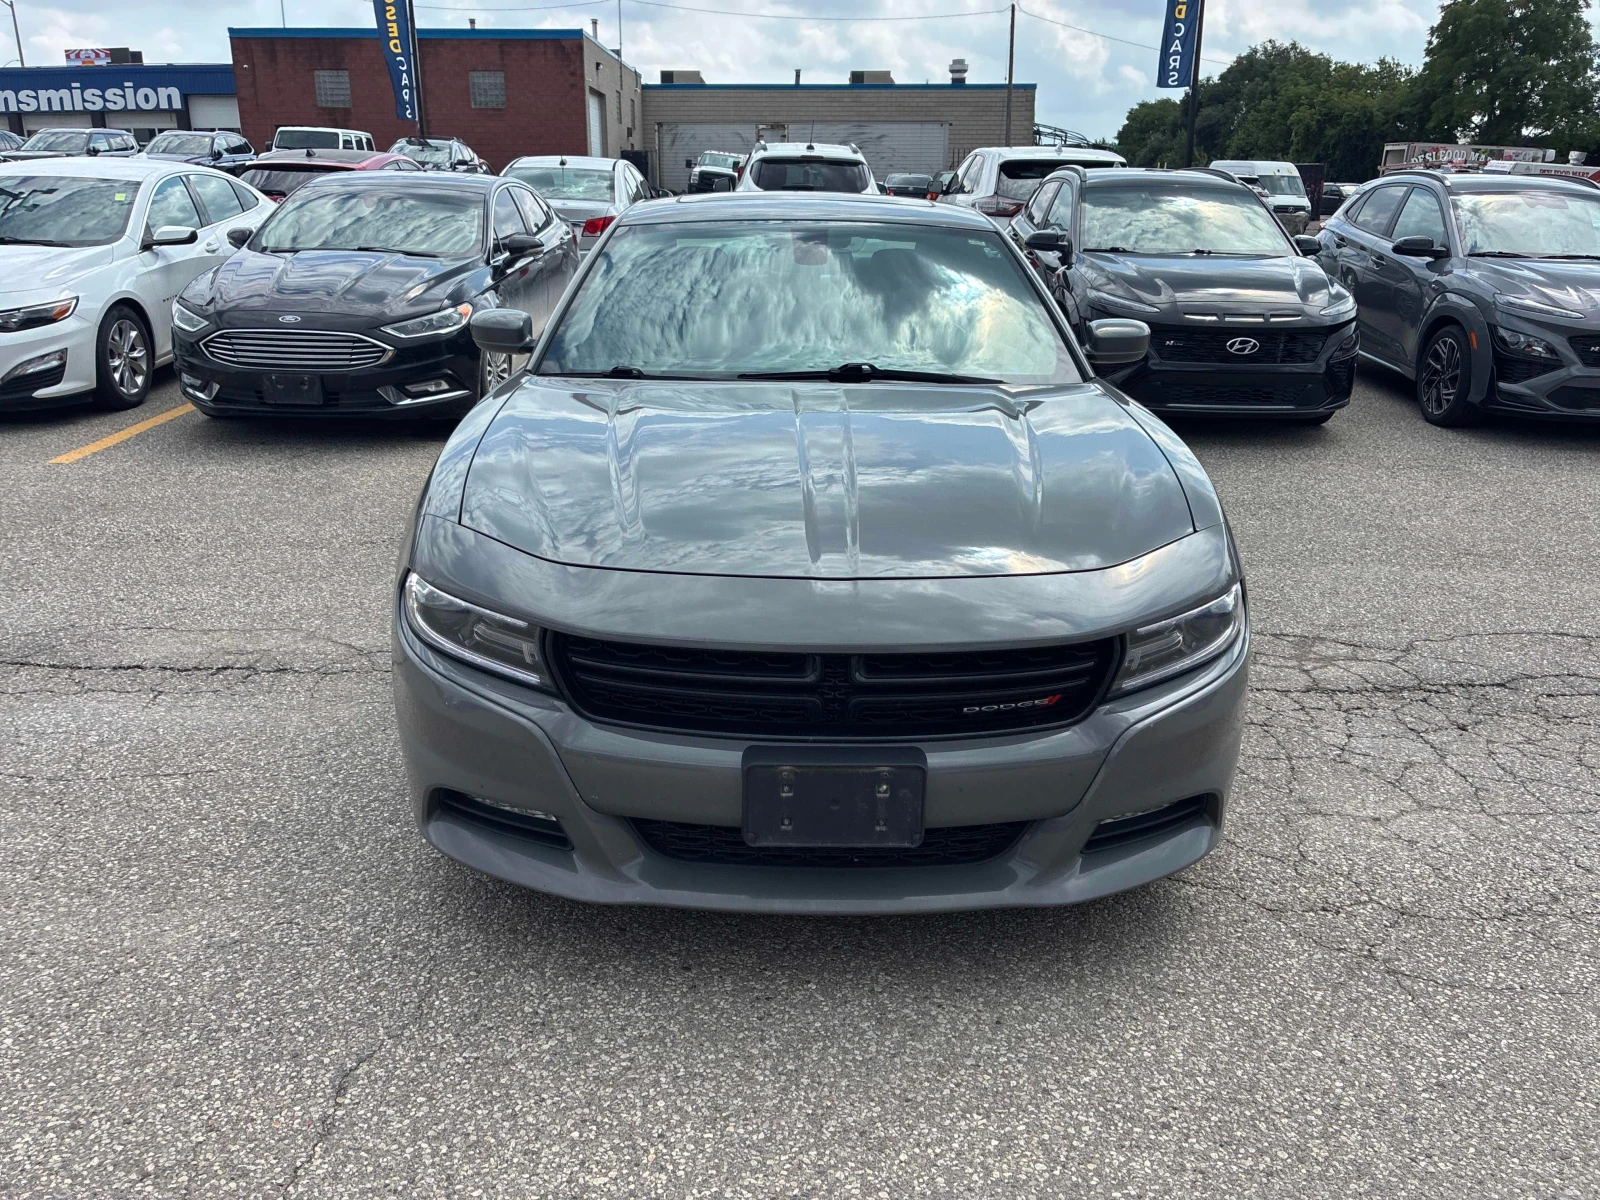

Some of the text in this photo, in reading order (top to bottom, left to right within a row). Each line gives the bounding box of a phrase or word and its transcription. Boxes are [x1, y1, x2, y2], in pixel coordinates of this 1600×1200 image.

[0, 82, 182, 112] nsmission
[1439, 149, 1467, 161] FOOD
[963, 698, 1049, 713] DODGE
